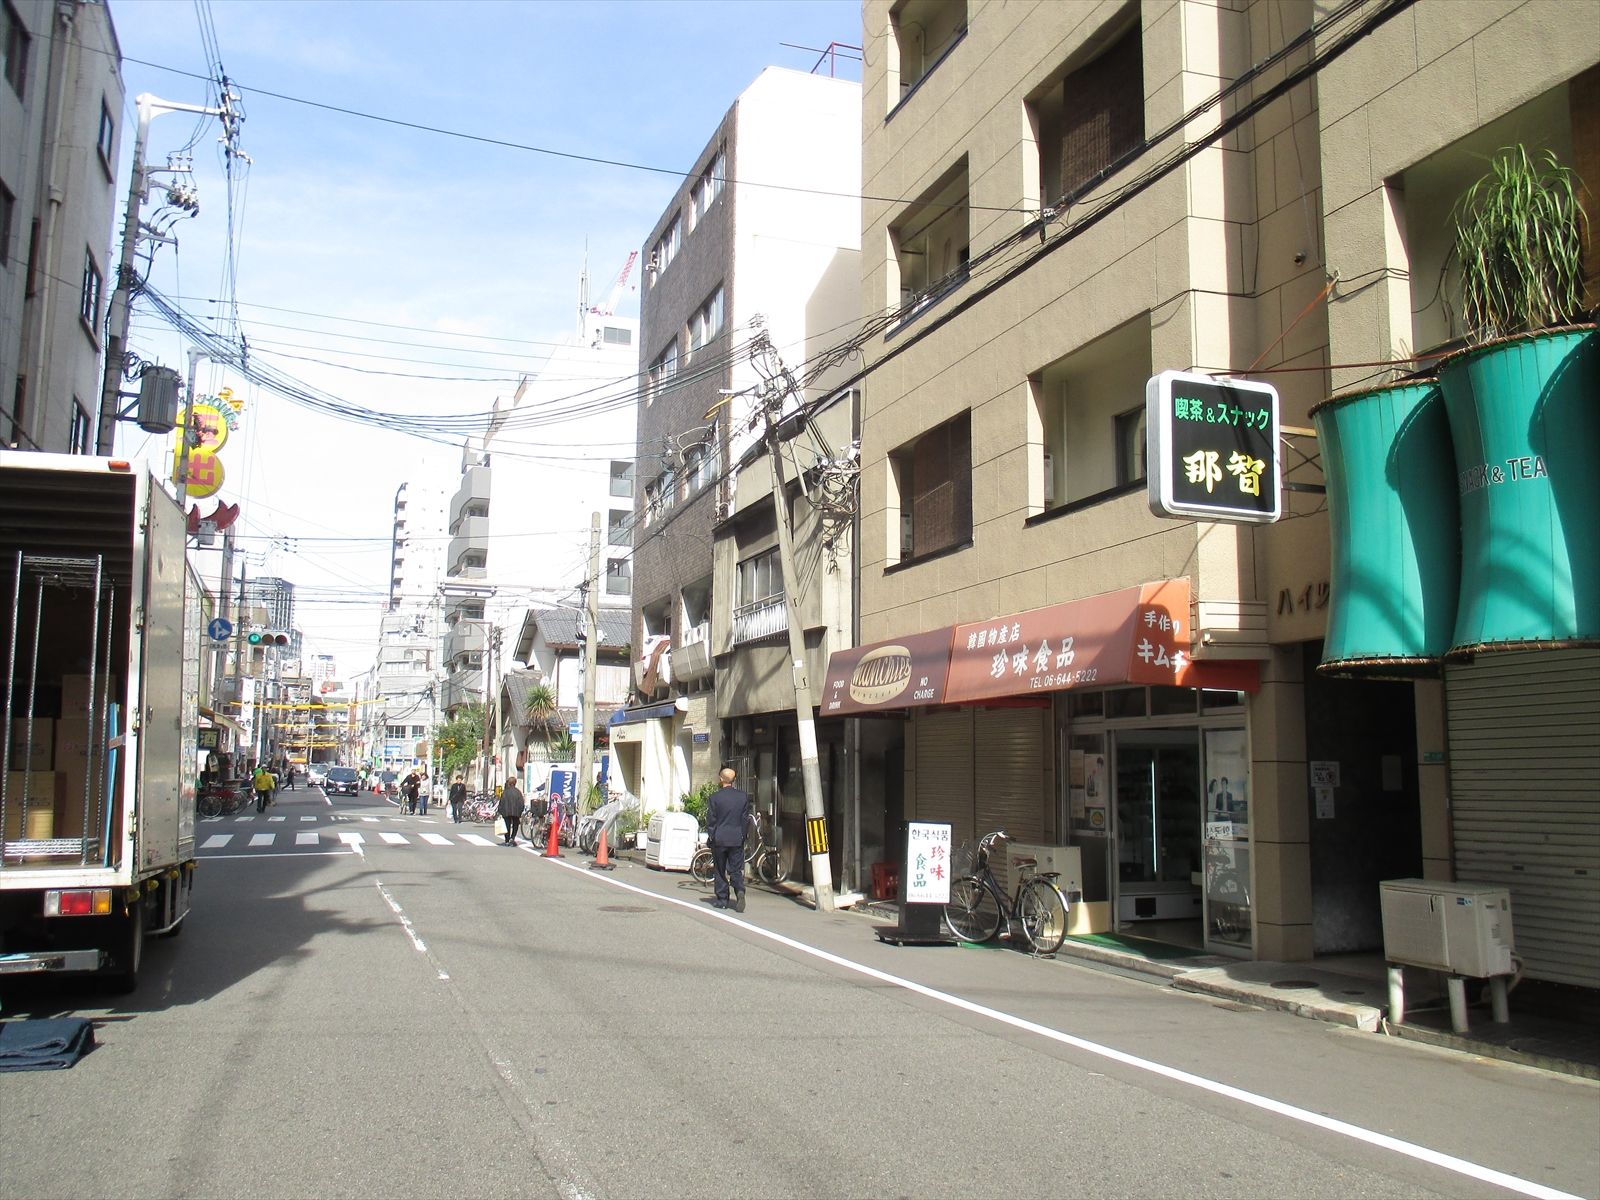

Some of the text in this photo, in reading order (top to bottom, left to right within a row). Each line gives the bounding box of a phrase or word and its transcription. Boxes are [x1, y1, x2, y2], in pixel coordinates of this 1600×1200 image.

[1174, 397, 1270, 430] 喫茶&スナック
[1182, 449, 1266, 497] 那智
[1492, 466, 1504, 484] &
[1506, 456, 1549, 481] TEA
[1144, 610, 1180, 635] 手作り
[990, 636, 1075, 679] 珍味食品
[1136, 638, 1188, 673] キムチ
[913, 688, 935, 700] CHARGE
[919, 676, 929, 687] NO
[1030, 677, 1042, 688] TEL
[913, 853, 927, 887] 食品
[930, 845, 945, 880] 珍味
